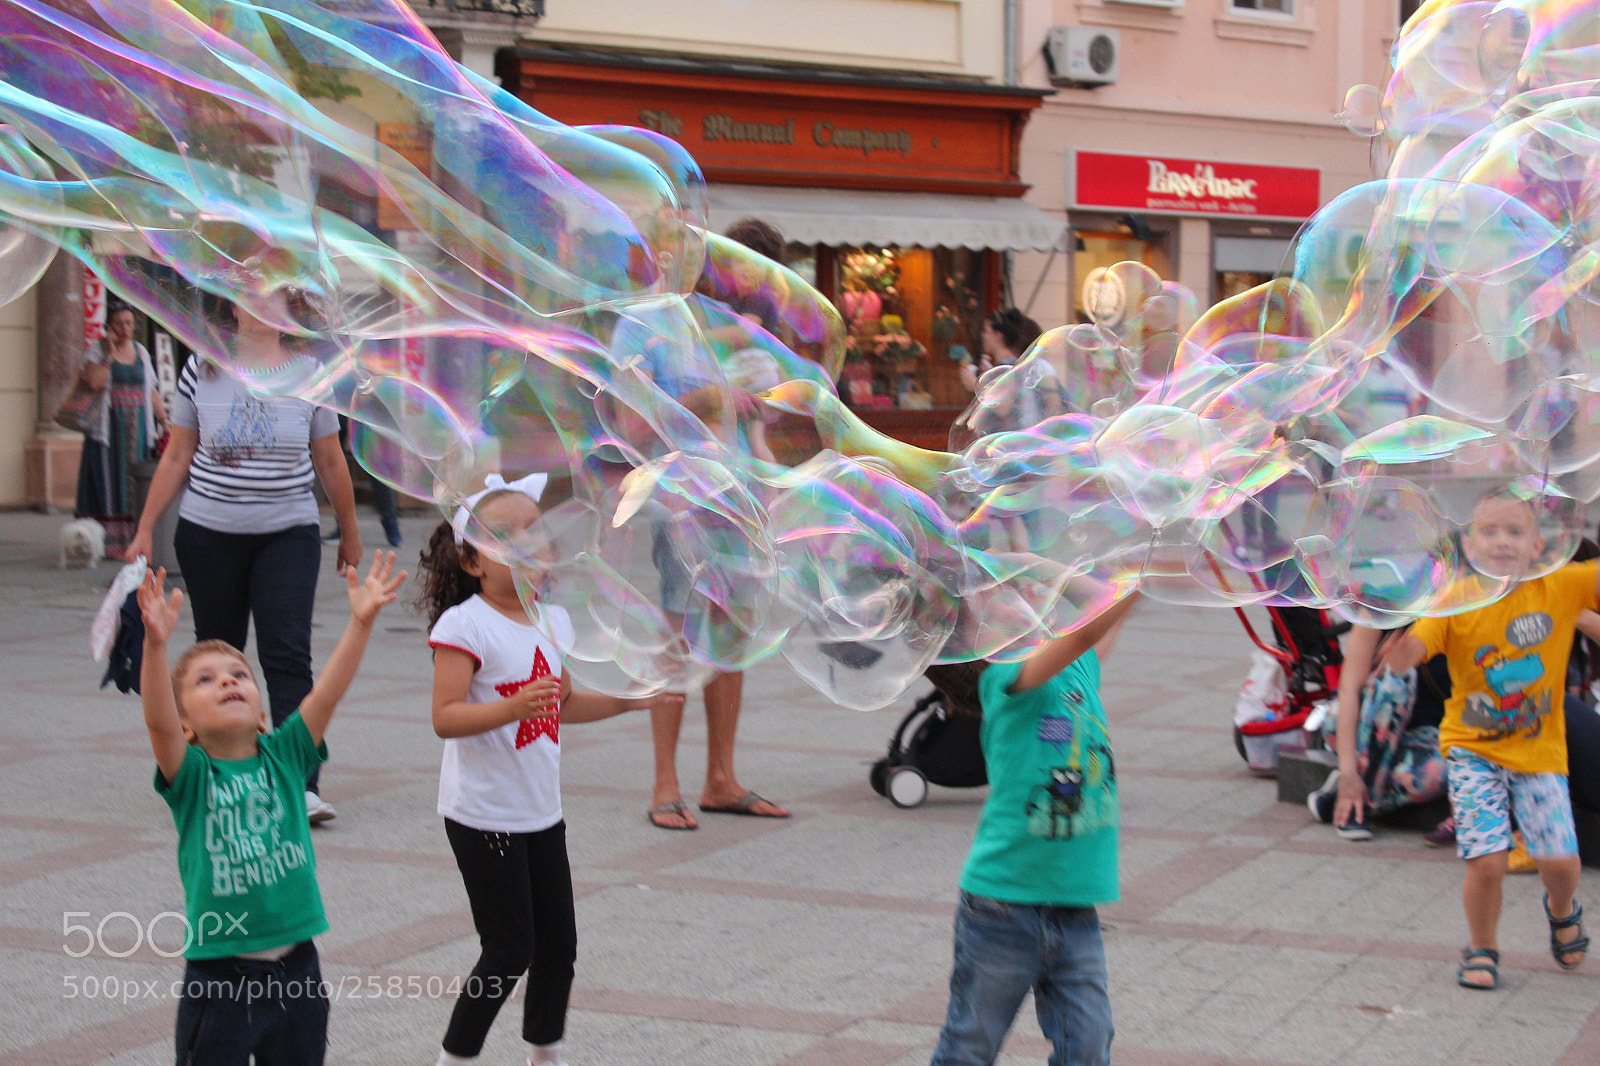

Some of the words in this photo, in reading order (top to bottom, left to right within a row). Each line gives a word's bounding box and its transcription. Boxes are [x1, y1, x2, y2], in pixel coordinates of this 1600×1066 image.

[639, 109, 684, 138] The
[703, 113, 796, 143] Manual
[812, 120, 912, 156] Company
[210, 839, 307, 897] BENETTON
